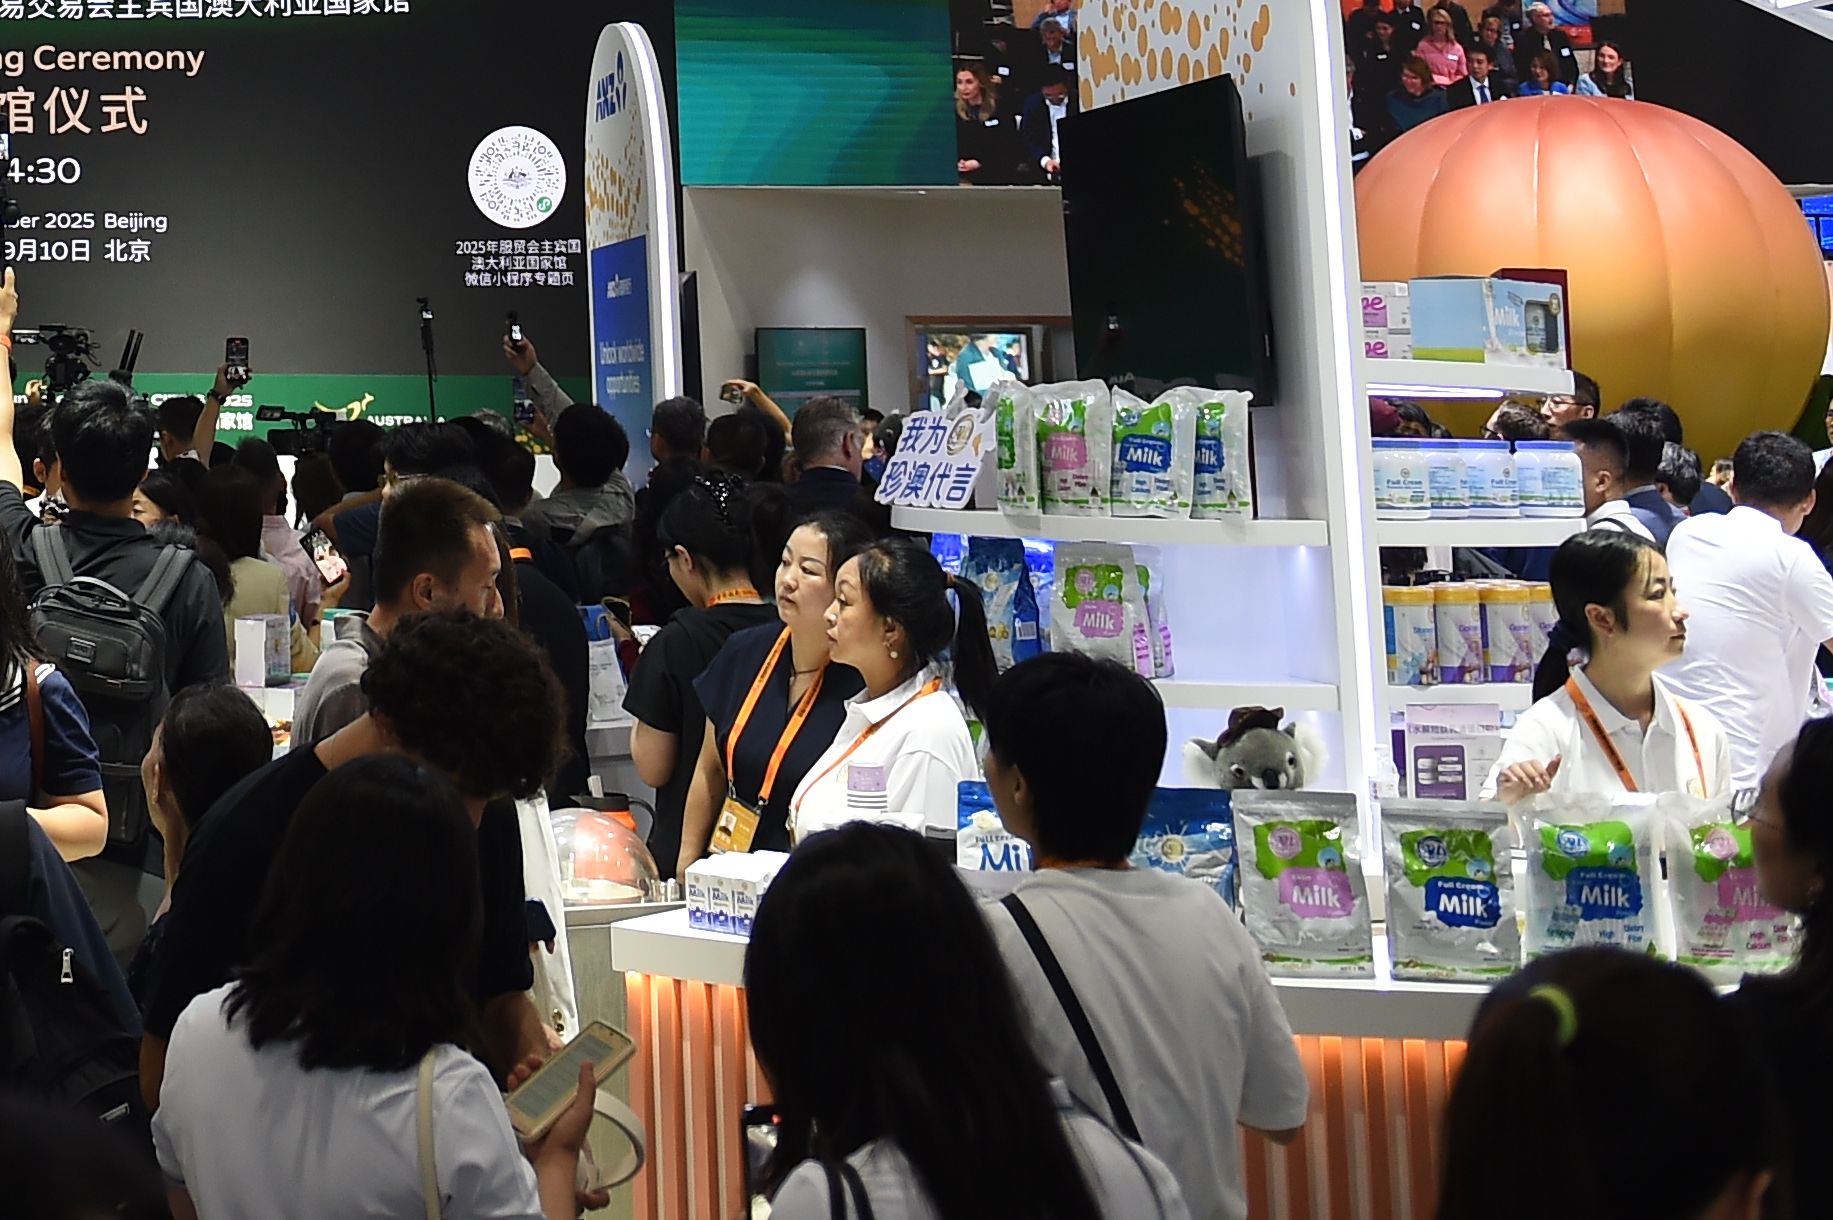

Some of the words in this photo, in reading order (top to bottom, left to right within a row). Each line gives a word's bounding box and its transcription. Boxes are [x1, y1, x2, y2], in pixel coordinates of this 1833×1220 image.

[33, 44, 205, 77] Ceremony
[596, 72, 616, 123] ANZ
[44, 212, 95, 229] 2025
[104, 212, 168, 233] Beijing
[104, 238, 152, 263] 北京
[455, 239, 582, 255] 2025年服贸会主宾国
[471, 255, 568, 270] 澳大利亚国家馆
[464, 271, 575, 287] 微信小程序专题页
[898, 415, 948, 454] 我为
[1126, 447, 1162, 467] Milk
[879, 460, 977, 502] 珍澳代言
[1082, 611, 1115, 631] Milk
[979, 843, 1034, 872] Mil
[1292, 884, 1341, 908] Milk
[1439, 893, 1488, 918] Milk
[1581, 883, 1630, 908] Milk
